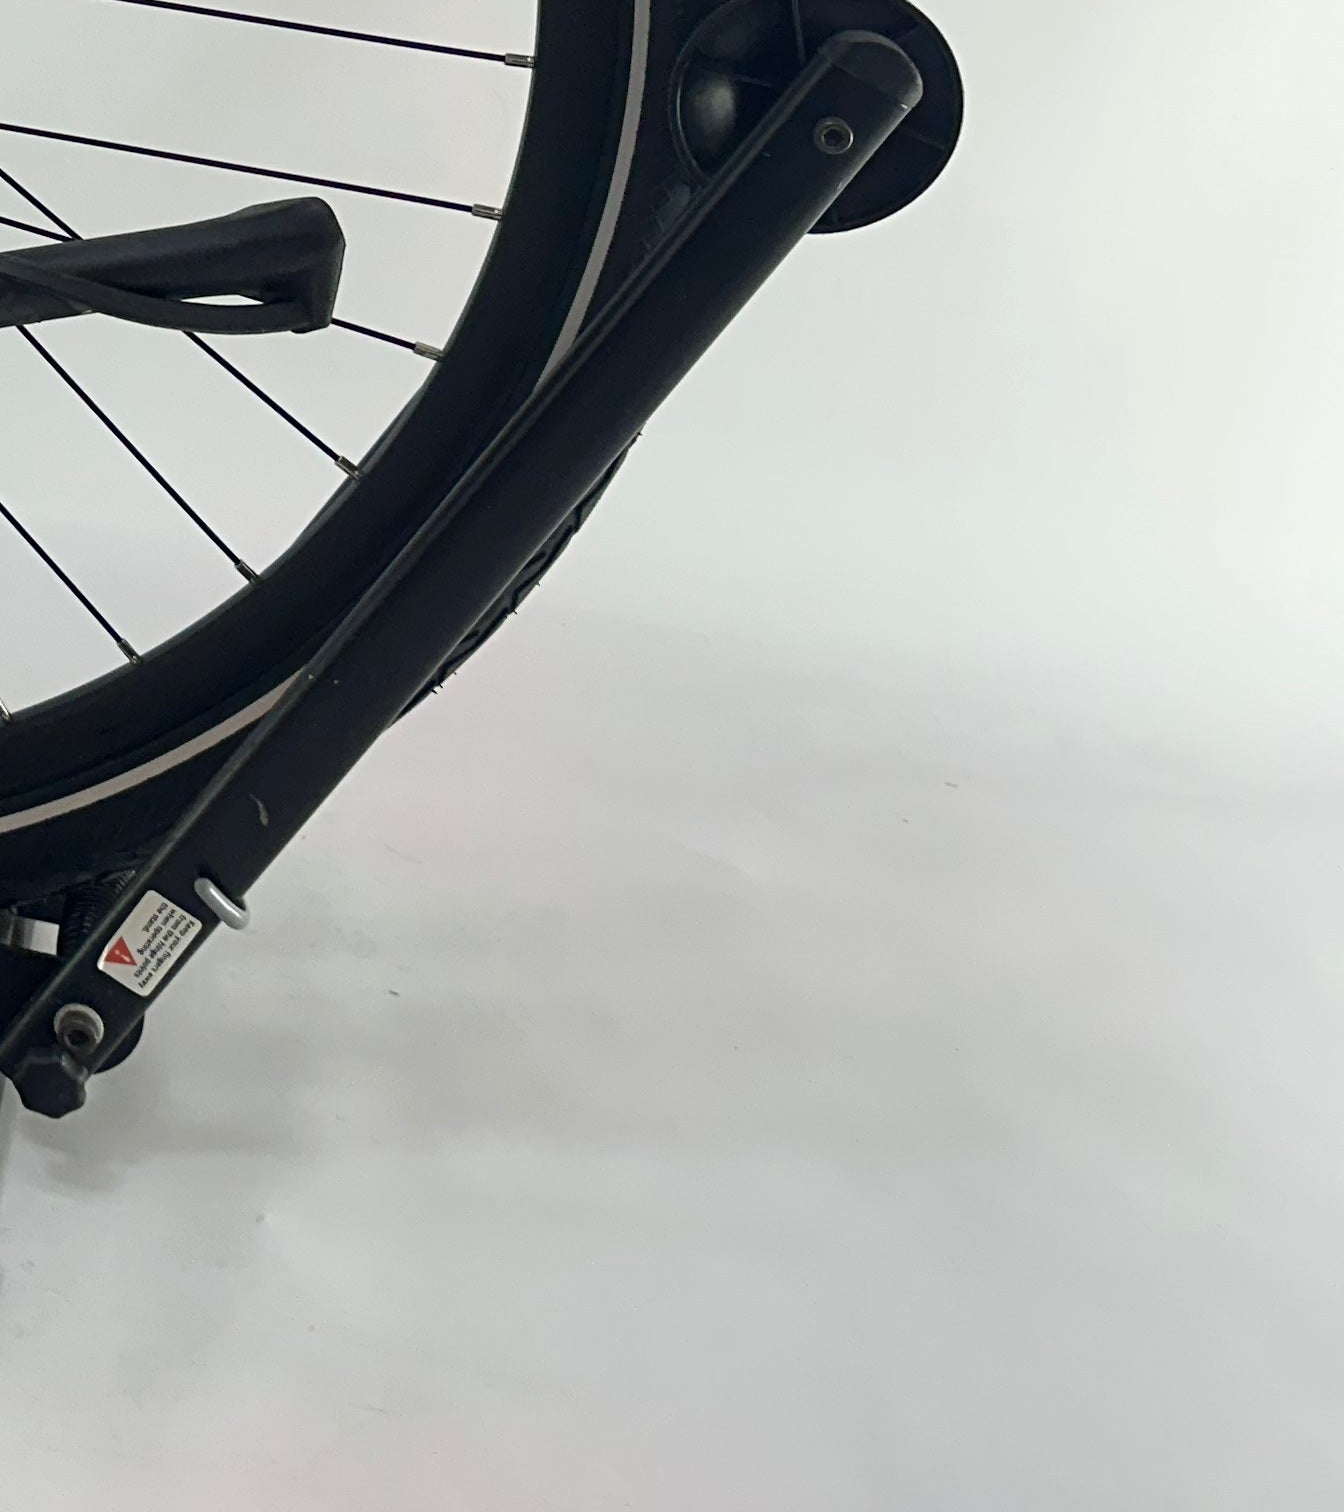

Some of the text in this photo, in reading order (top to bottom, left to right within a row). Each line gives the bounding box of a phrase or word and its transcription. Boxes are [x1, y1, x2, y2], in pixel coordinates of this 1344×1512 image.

[157, 902, 168, 914] the
[171, 914, 186, 930] from
[136, 925, 164, 955] operating
[162, 930, 174, 941] the
[138, 920, 195, 987] Keep your fingers away
[148, 940, 165, 958] hinge
